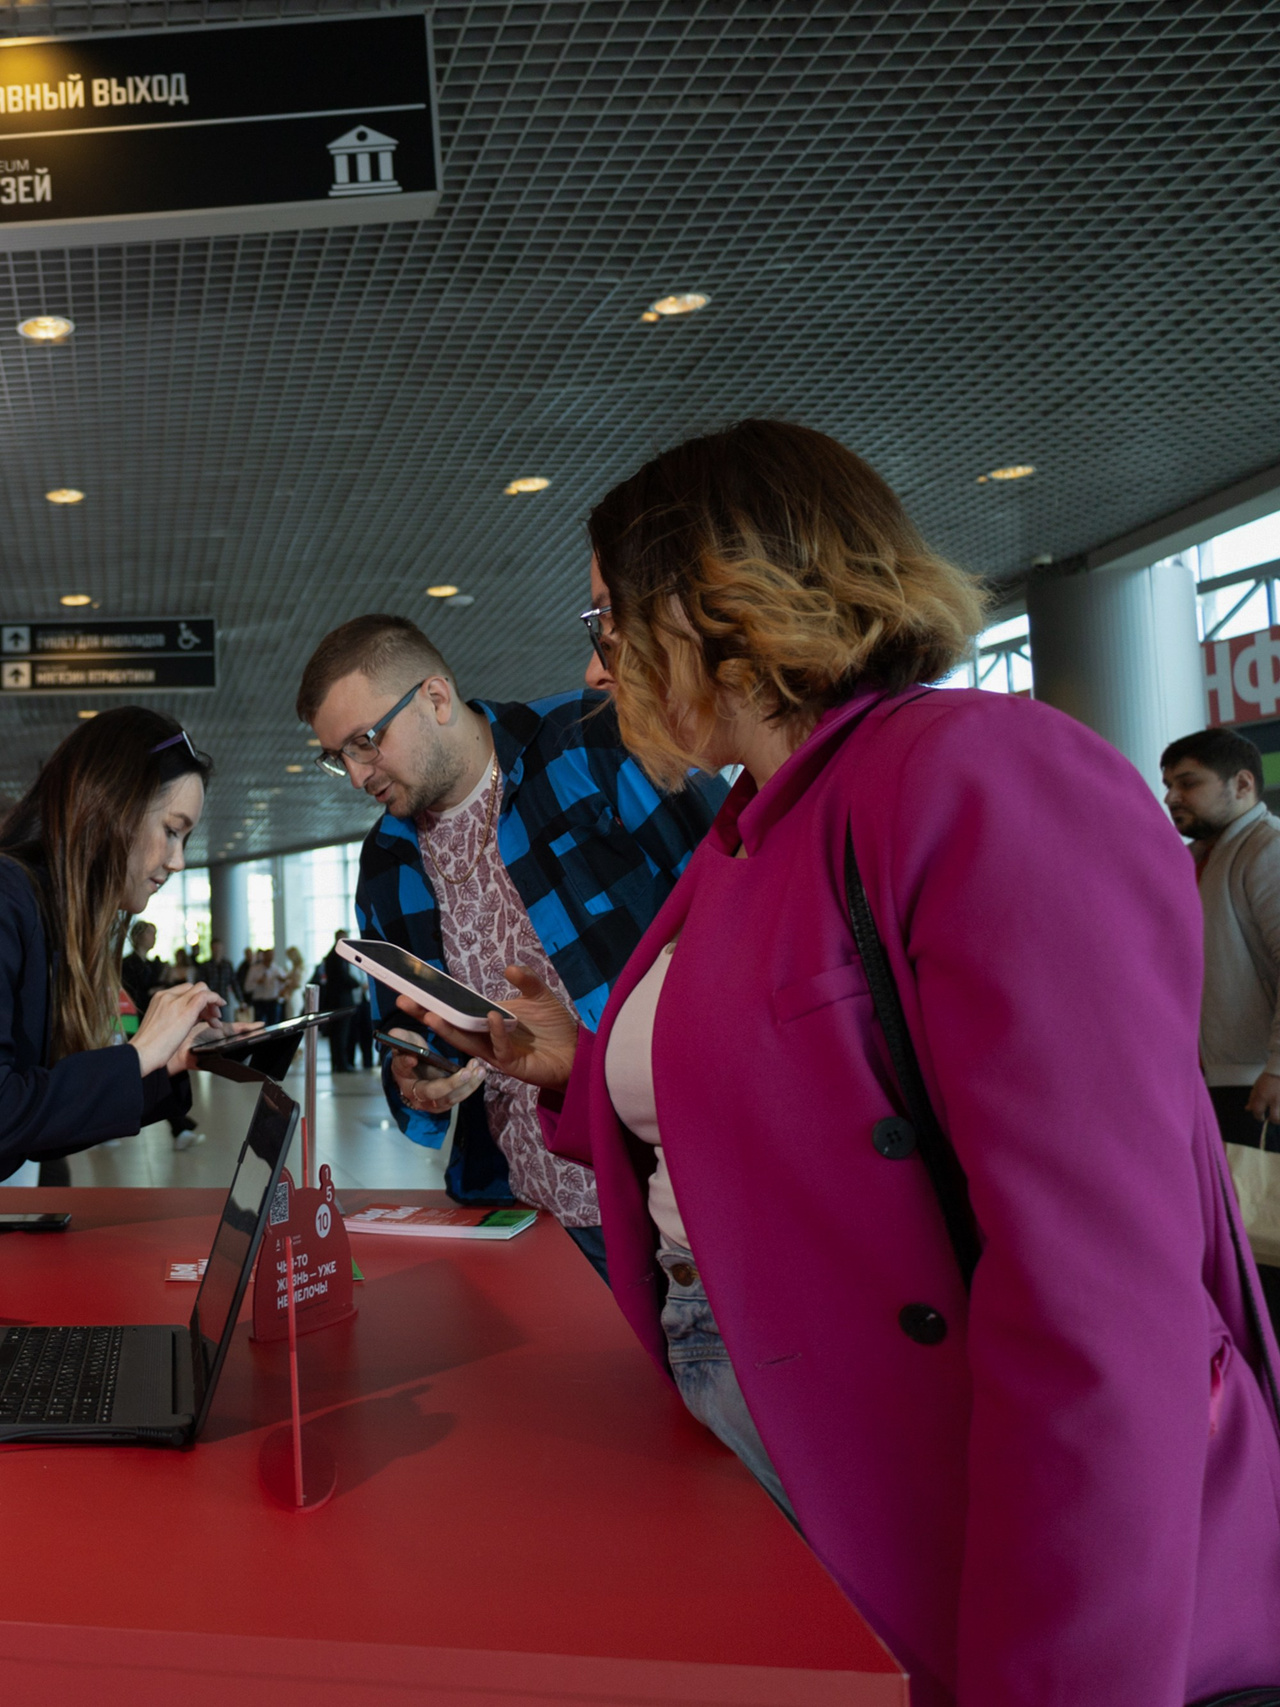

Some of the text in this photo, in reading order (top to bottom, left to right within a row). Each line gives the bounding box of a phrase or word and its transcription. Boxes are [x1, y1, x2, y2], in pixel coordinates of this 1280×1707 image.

[92, 73, 189, 107] ВЫХОД
[326, 1185, 333, 1202] 5
[317, 1212, 329, 1231] 10
[318, 1261, 336, 1277] УЖЕ
[276, 1295, 288, 1310] НЕ
